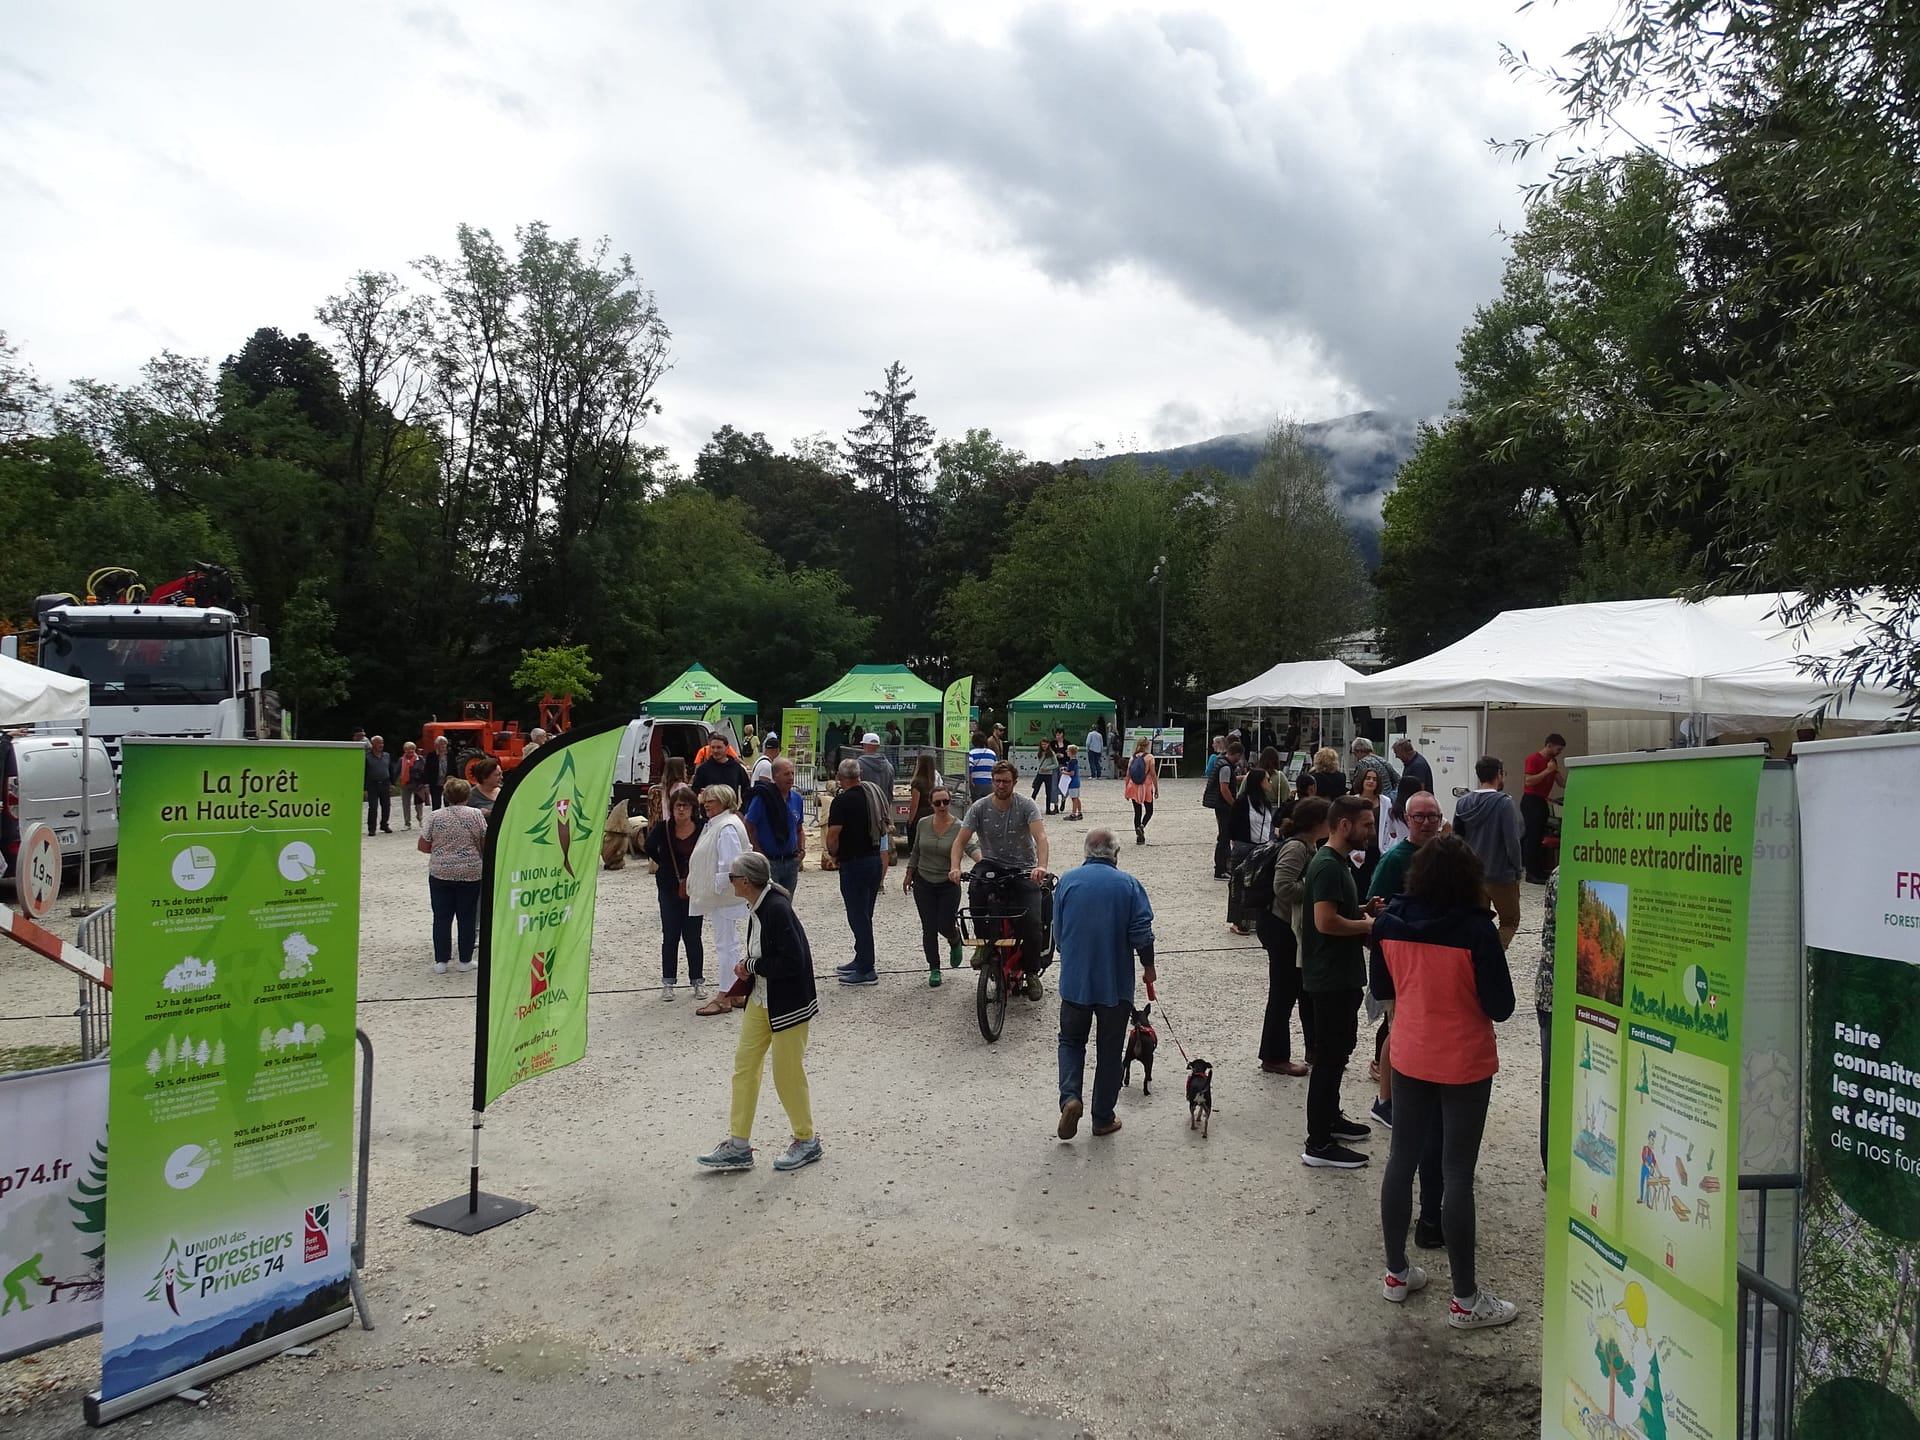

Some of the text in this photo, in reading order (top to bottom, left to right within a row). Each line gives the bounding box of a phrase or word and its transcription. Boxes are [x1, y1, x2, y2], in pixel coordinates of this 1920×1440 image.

[874, 703, 917, 711] www.ufp74.fr
[1042, 702, 1087, 710] www.ufp74.fr
[202, 768, 299, 798] La forêt
[161, 798, 331, 822] en Haute-Savoie
[1584, 806, 1598, 828] La
[1604, 804, 1634, 830] forêt
[1646, 811, 1664, 831] un
[1669, 804, 1708, 837] puits
[1713, 804, 1732, 833] de
[1573, 840, 1743, 877] carbone extraordinaire
[45, 875, 53, 887] m
[512, 867, 562, 883] UNION de
[152, 899, 160, 908] 71
[172, 897, 182, 906] de
[184, 896, 203, 905] forêt
[205, 895, 228, 904] privée
[166, 906, 214, 918] (132 000 ha)
[196, 970, 206, 978] ha
[277, 982, 290, 990] 000
[156, 994, 222, 1009] 1,7 ha de surface
[144, 1002, 232, 1021] moyenne de propriété
[1835, 1021, 1881, 1049] Faire
[154, 1080, 165, 1089] 51
[176, 1076, 186, 1086] de
[188, 1071, 220, 1083] résineux
[1834, 1052, 1920, 1089] connaître
[1833, 1074, 1858, 1098] les
[234, 1127, 250, 1138] 90%
[250, 1126, 260, 1134] de
[262, 1122, 277, 1132] bois
[1832, 1105, 1905, 1141] et défis
[234, 1136, 264, 1148] résineux
[266, 1132, 278, 1141] soit
[1831, 1129, 1852, 1151] de
[1857, 1140, 1890, 1164] nos
[185, 1230, 247, 1258] UNION des
[194, 1230, 294, 1278] Forestiers
[200, 1254, 284, 1298] Privés 74
